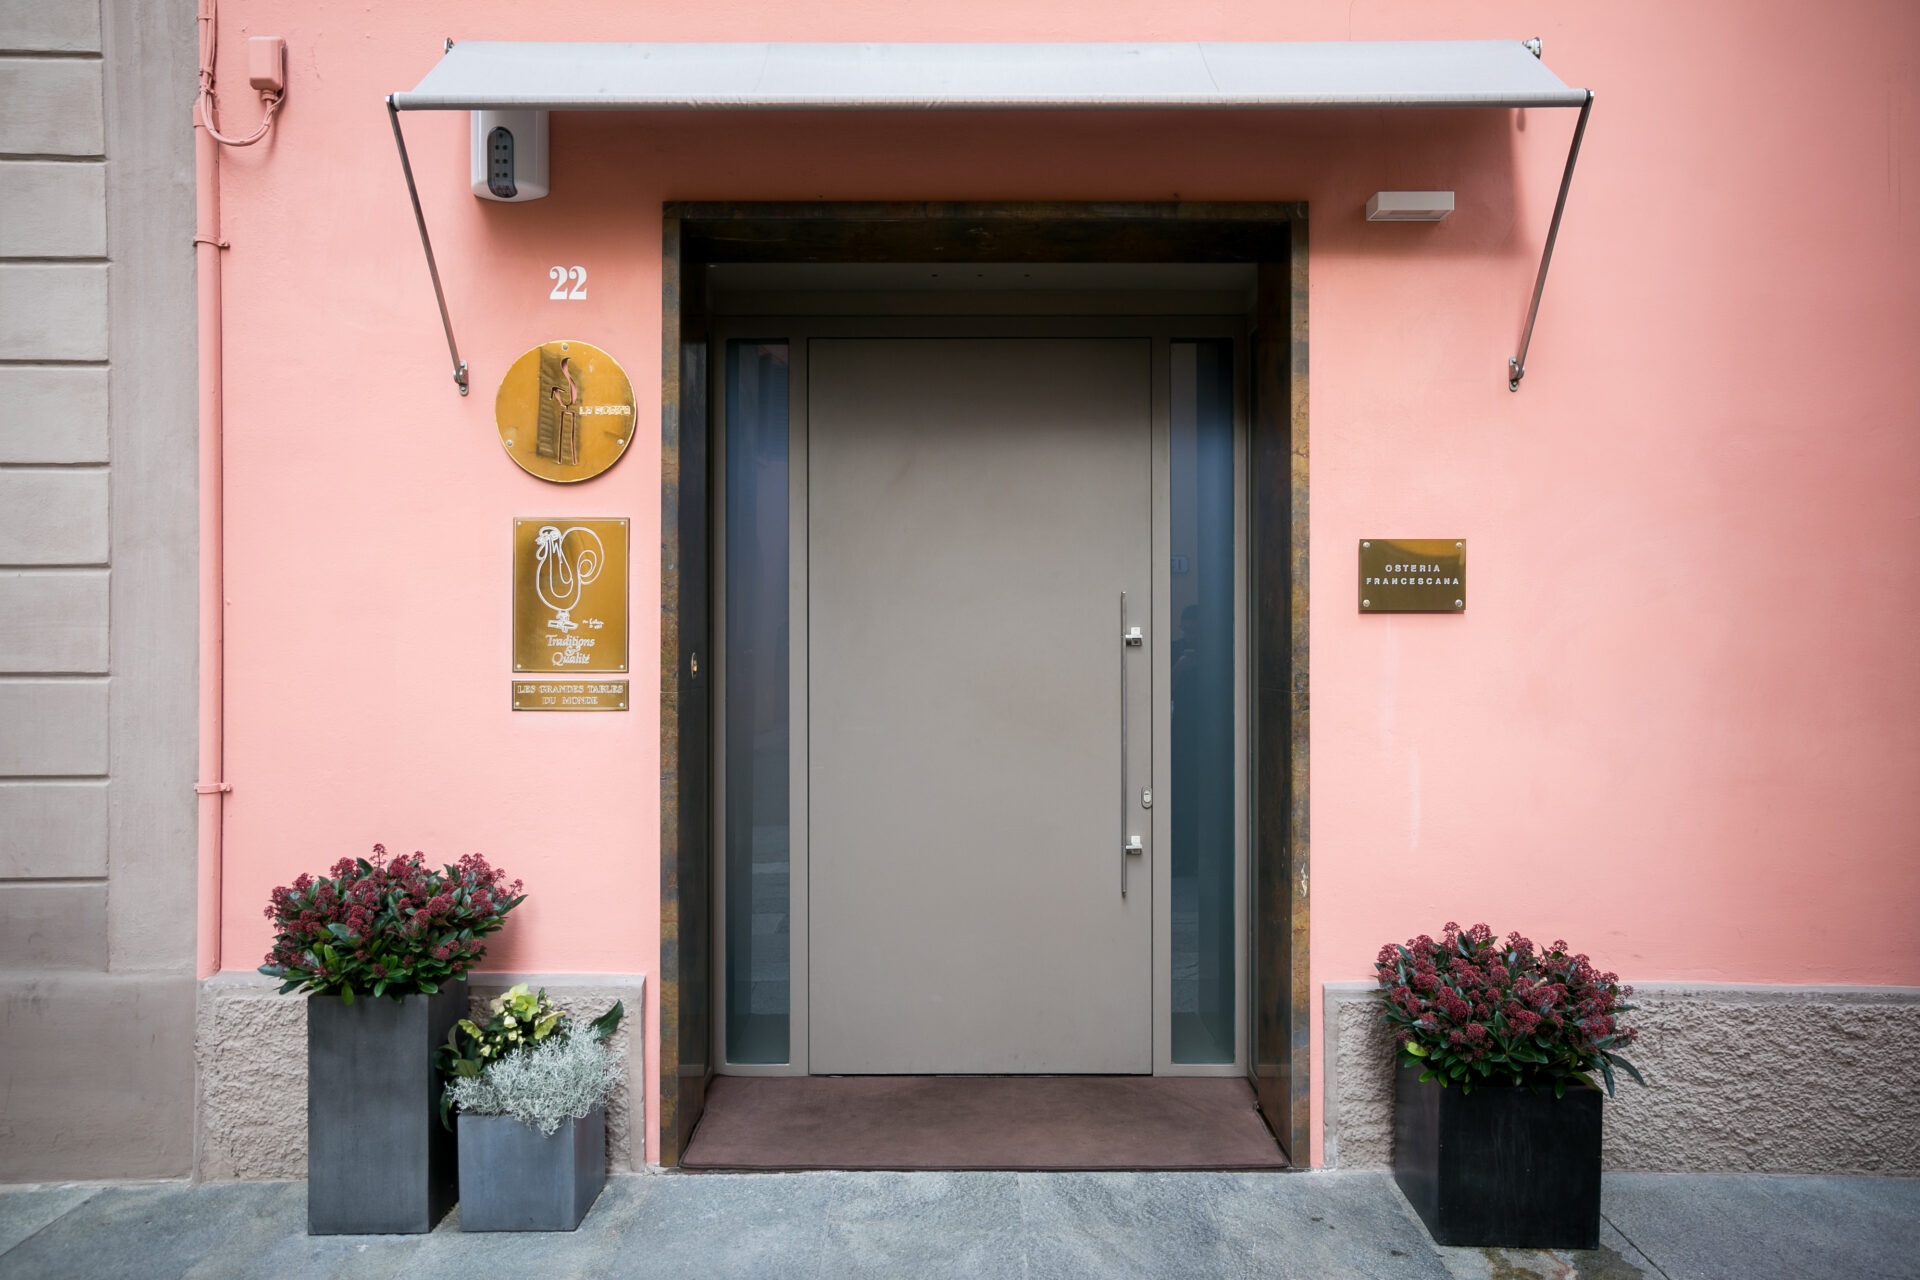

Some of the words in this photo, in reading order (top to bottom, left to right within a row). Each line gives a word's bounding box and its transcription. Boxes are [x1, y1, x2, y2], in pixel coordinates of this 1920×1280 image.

[550, 266, 587, 300] 22
[1384, 564, 1441, 573] OSTERIA
[1365, 577, 1460, 585] FRANCESCANA
[545, 634, 596, 647] Traditions
[564, 645, 581, 656] &
[517, 684, 537, 694] LES
[539, 684, 585, 694] GRANDES
[587, 684, 624, 694] TABLES
[543, 696, 556, 705] DU
[562, 696, 598, 705] MONDE
